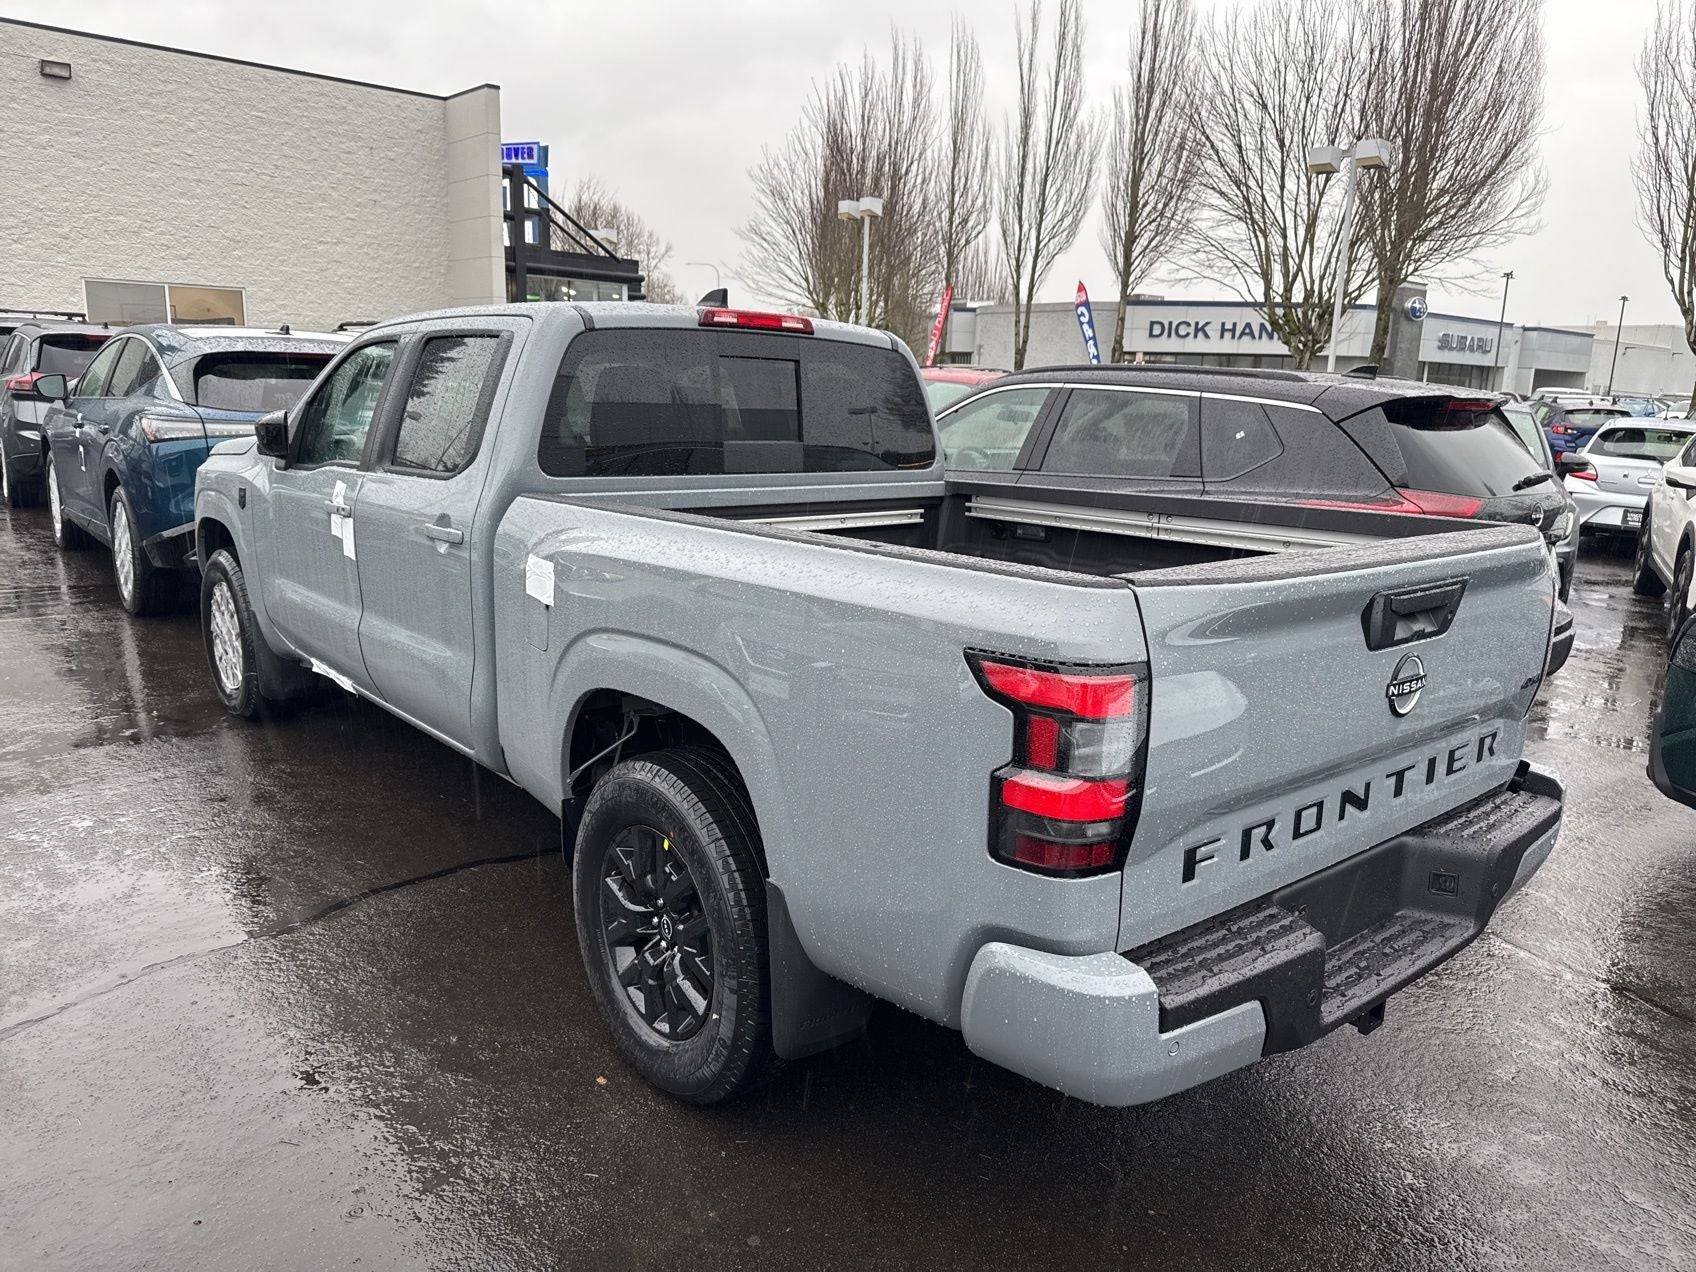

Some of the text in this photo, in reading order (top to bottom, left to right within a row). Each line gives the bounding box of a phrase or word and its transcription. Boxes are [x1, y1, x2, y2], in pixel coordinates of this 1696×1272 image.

[1148, 320, 1281, 341] DICK HAN
[1437, 333, 1494, 354] SUBARU
[1182, 731, 1498, 884] FRONTIER
